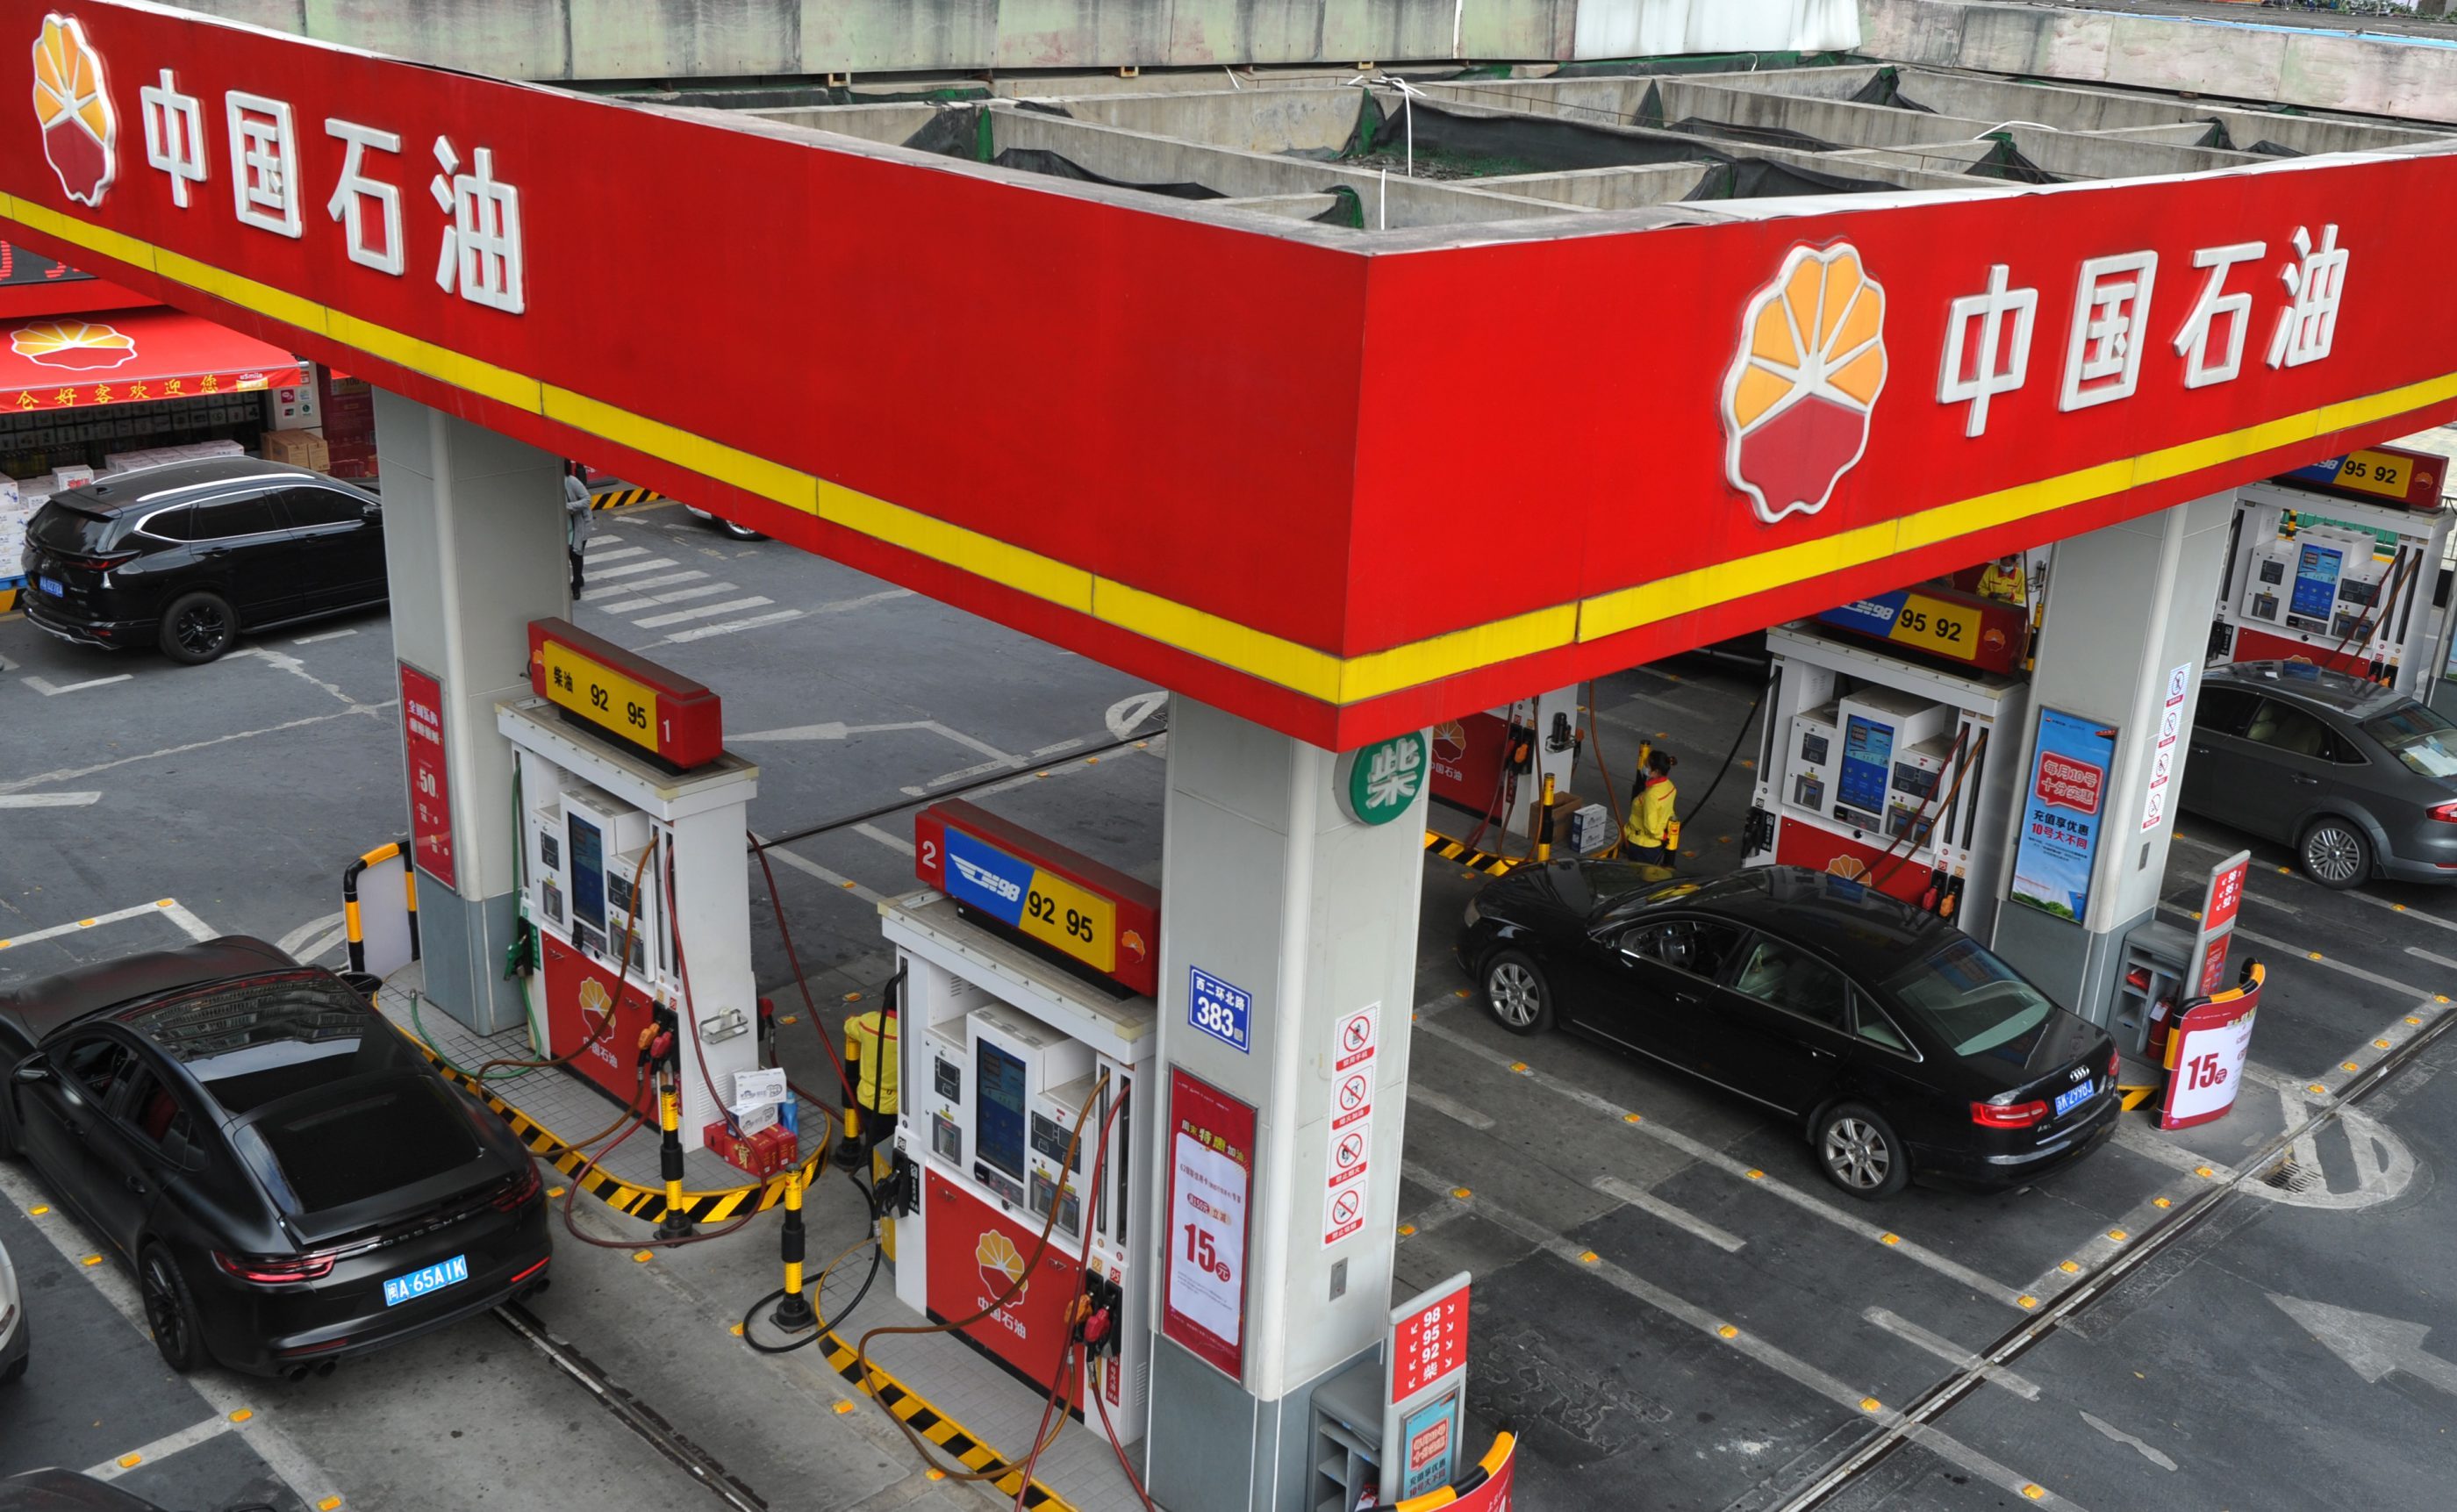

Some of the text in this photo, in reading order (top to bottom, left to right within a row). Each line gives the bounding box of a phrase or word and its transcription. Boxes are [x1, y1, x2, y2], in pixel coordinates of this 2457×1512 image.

[140, 68, 526, 314] 中国石油
[1937, 223, 2349, 438] 中国石油
[2345, 461, 2367, 477] 95
[2374, 466, 2396, 484] 92
[1901, 609, 1927, 632] 95
[1936, 619, 1962, 641] 92
[553, 666, 670, 742] 柴油 92 95 1
[419, 769, 436, 798] 50
[1365, 738, 1421, 809] 柴
[2045, 760, 2098, 787] 每月10号
[2041, 777, 2095, 806] 十分实惠
[2031, 823, 2088, 849] 10号大不同
[2033, 809, 2089, 837] 充值享优惠
[922, 841, 936, 869] 2
[1028, 891, 1055, 925] 92
[1065, 909, 1093, 943] 95
[1196, 976, 1245, 1011] 西二环北路
[1197, 996, 1234, 1037] 383
[1110, 1269, 1121, 1282] 95
[1423, 1307, 1441, 1328] 98
[1422, 1324, 1440, 1346] 95
[1422, 1343, 1439, 1364] 92
[1423, 1361, 1437, 1381] 柴
